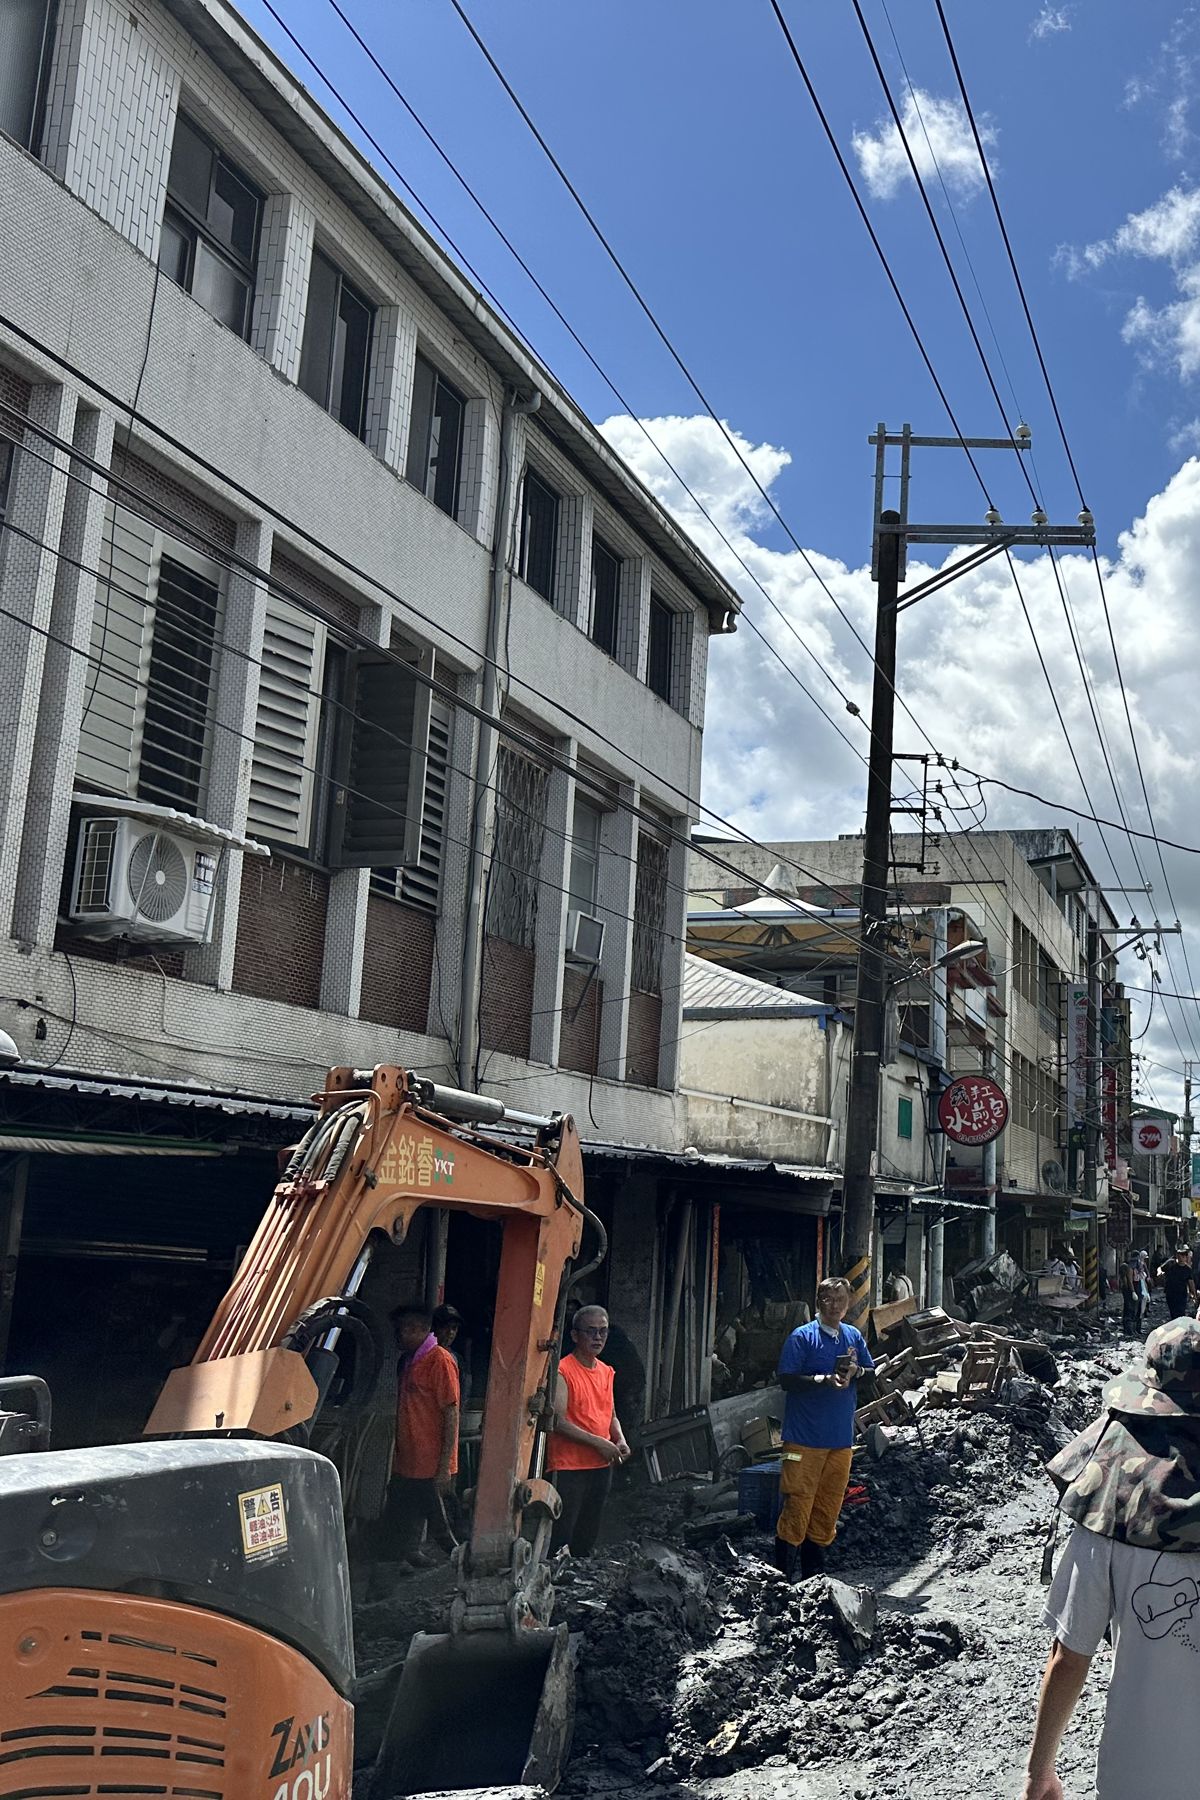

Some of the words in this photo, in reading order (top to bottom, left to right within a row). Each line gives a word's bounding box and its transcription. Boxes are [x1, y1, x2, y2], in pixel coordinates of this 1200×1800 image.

[945, 1097, 1004, 1133] 水煎包
[1139, 1132, 1161, 1145] SYM
[434, 1158, 455, 1176] YKT
[268, 1711, 330, 1779] ZAXIS
